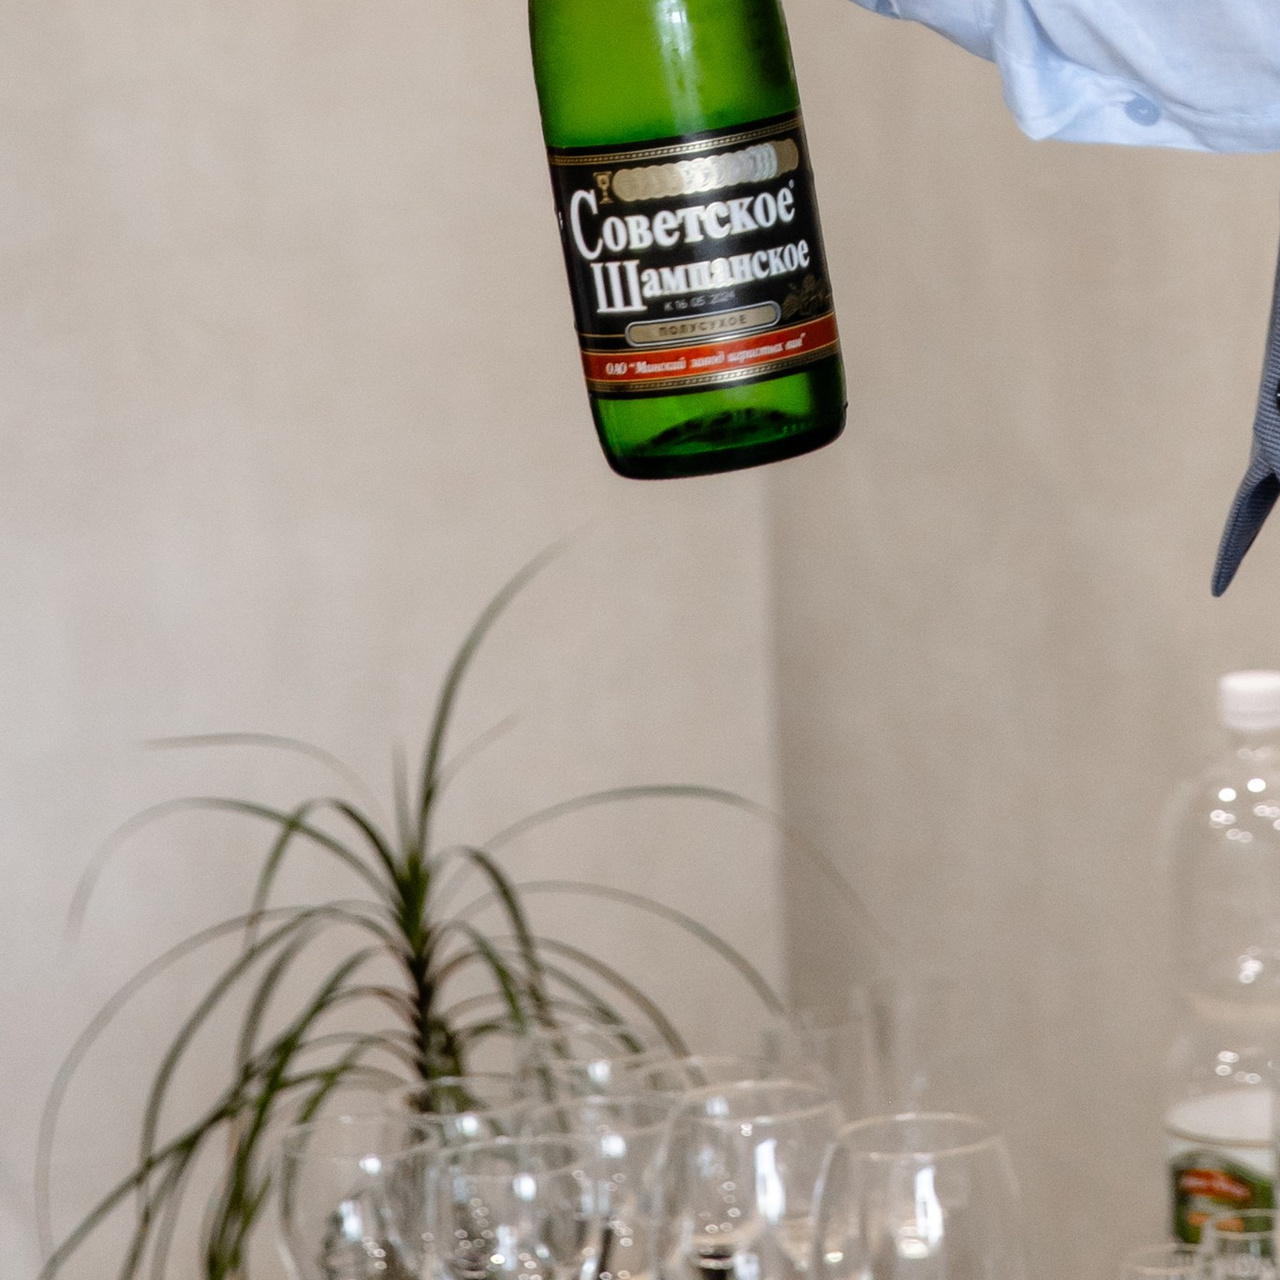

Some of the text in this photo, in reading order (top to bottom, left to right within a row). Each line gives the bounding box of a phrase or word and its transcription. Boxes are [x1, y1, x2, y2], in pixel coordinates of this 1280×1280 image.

[570, 188, 795, 259] Советское
[590, 239, 810, 313] Шампанское
[658, 314, 748, 336] ПОЛУСУХОЕ
